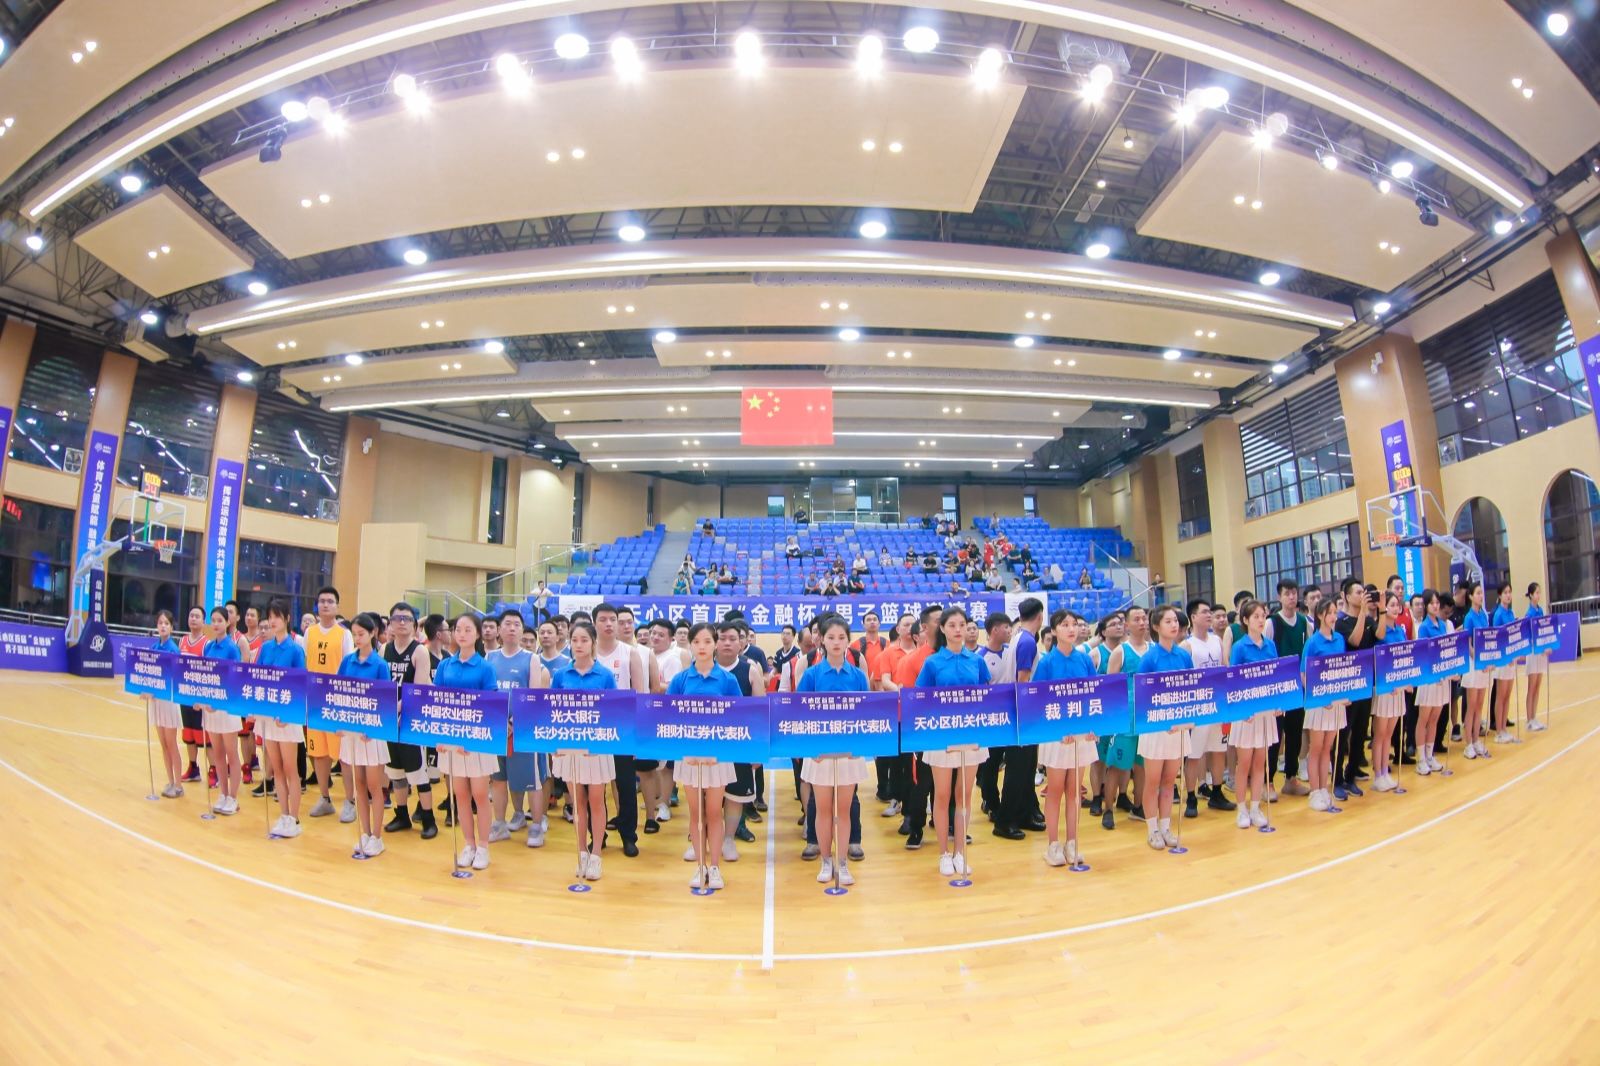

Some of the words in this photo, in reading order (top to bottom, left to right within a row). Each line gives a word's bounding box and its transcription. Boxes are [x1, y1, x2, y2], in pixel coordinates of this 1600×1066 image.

[318, 653, 326, 664] 13
[184, 671, 220, 686] 中华联合财险
[242, 684, 292, 704] 华泰证券
[1152, 688, 1214, 706] 中国进出口银行
[1226, 679, 1299, 704] 长沙农商银行代表队
[325, 692, 378, 712] 中国建设银行
[1045, 698, 1103, 720] 裁判员
[322, 707, 382, 728] 天心支行代表队
[422, 704, 482, 722] 中国农业银行
[551, 710, 600, 724] 光大银行
[914, 712, 1010, 730] 天心区机关代表队
[1147, 702, 1218, 722] 湖南省分行代表队
[411, 720, 492, 740] 天心区支行代表队
[534, 726, 620, 742] 长沙分行代表队
[656, 724, 751, 741] 湘财证券代表队
[778, 720, 892, 735] 华融湘江银行代表队
